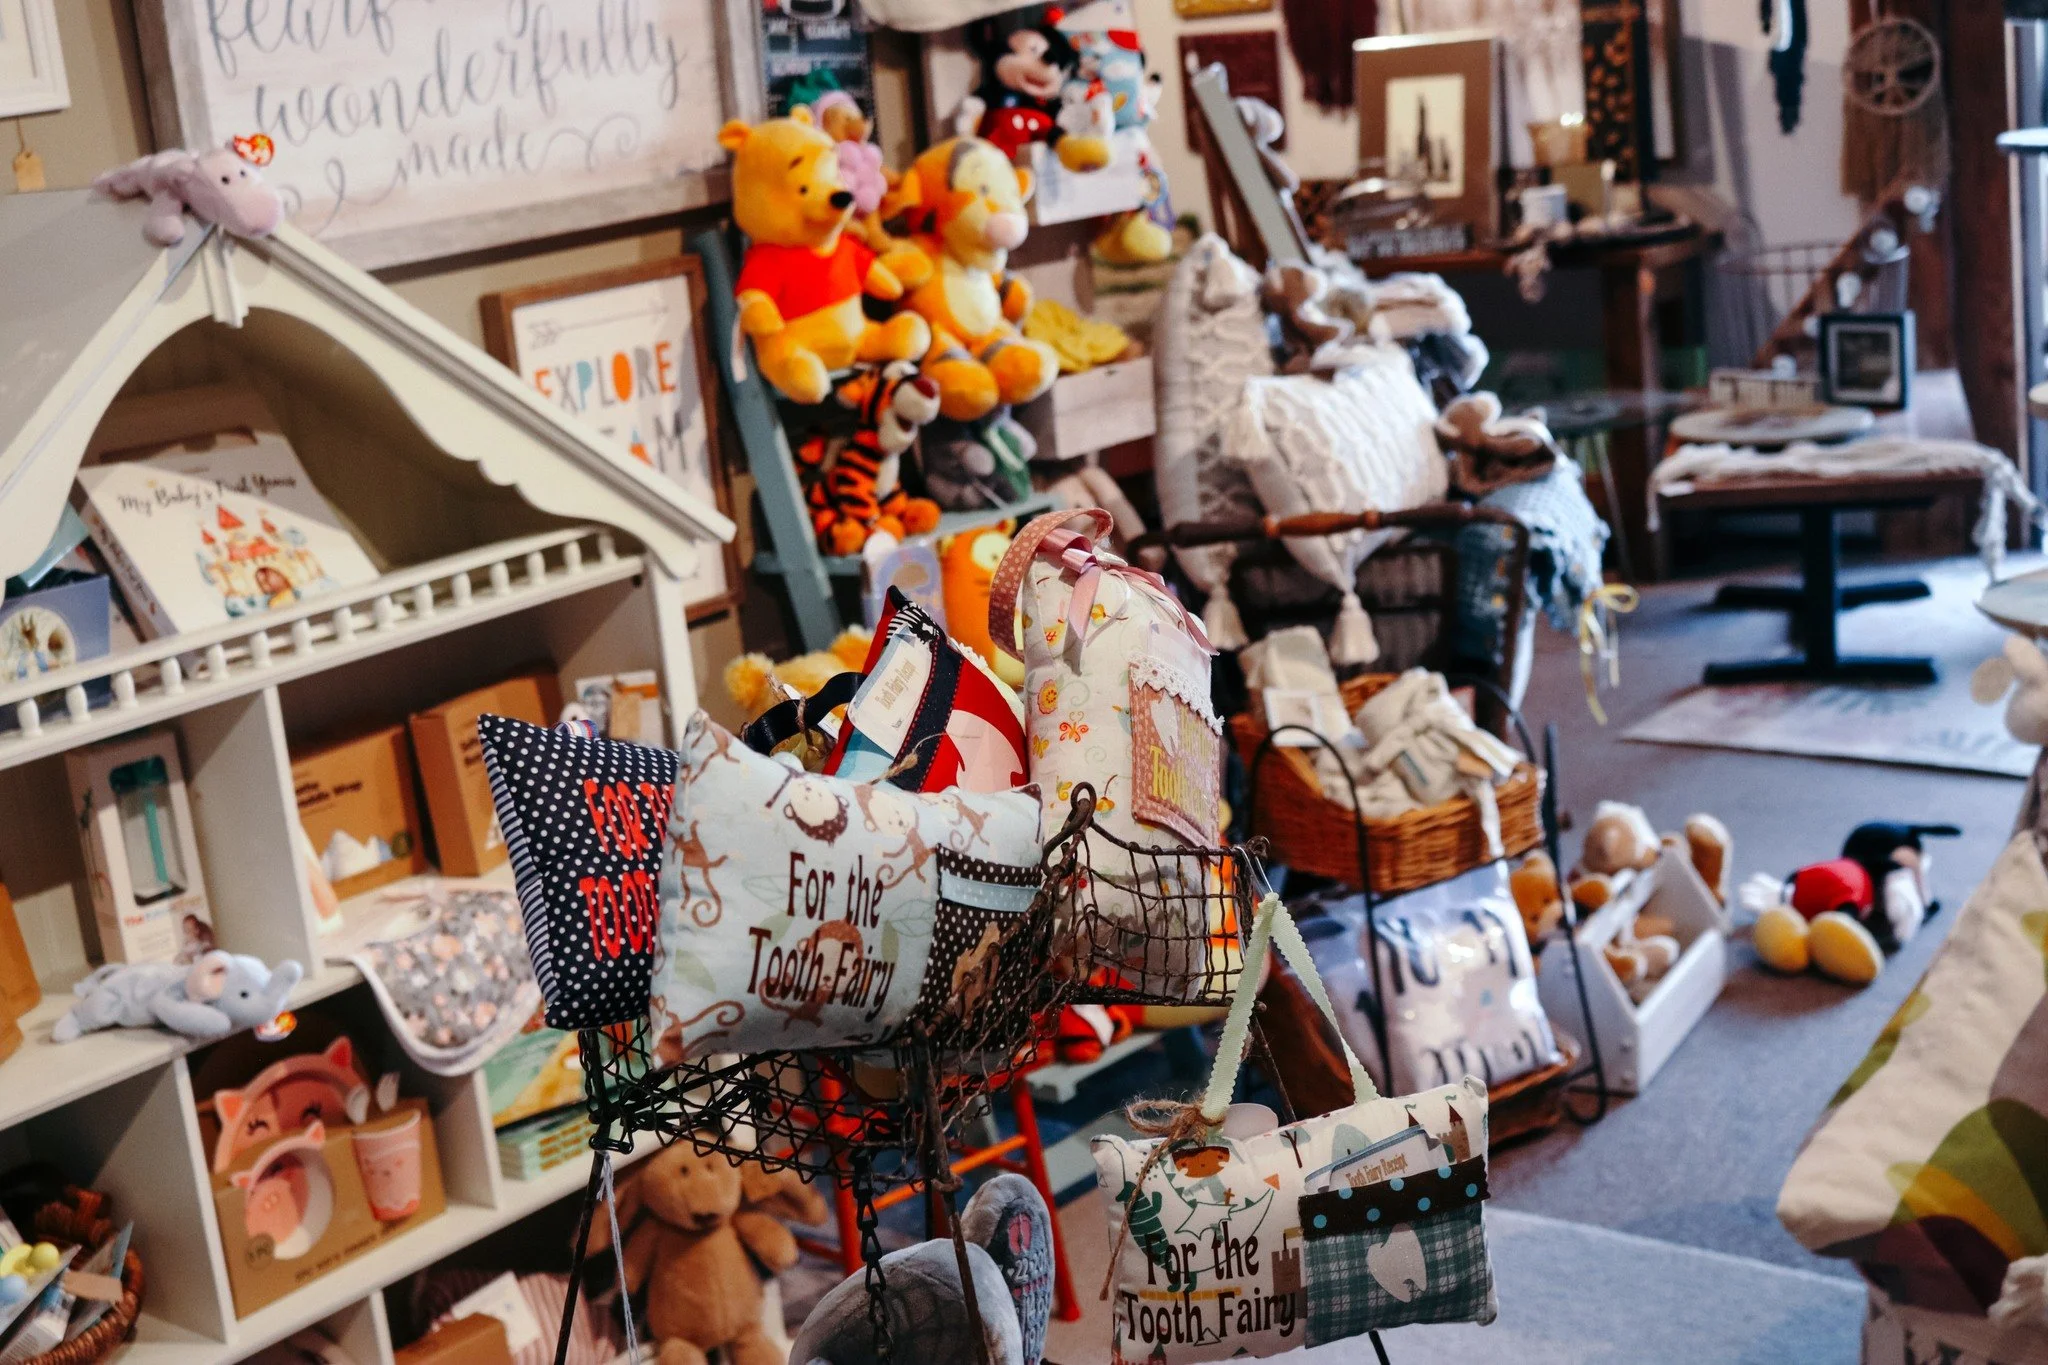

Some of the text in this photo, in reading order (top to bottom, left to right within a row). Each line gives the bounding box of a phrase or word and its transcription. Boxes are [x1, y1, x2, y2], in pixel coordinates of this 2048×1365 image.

[255, 0, 688, 147] wonderfully
[583, 778, 650, 862] FOR
[786, 851, 884, 929] For the
[747, 926, 896, 1023] Tooth Fairy
[1345, 1168, 1367, 1188] Tooth
[1363, 1165, 1383, 1184] Fairy
[1144, 1221, 1259, 1285] For the
[1121, 1287, 1296, 1344] Tooth Fairy
